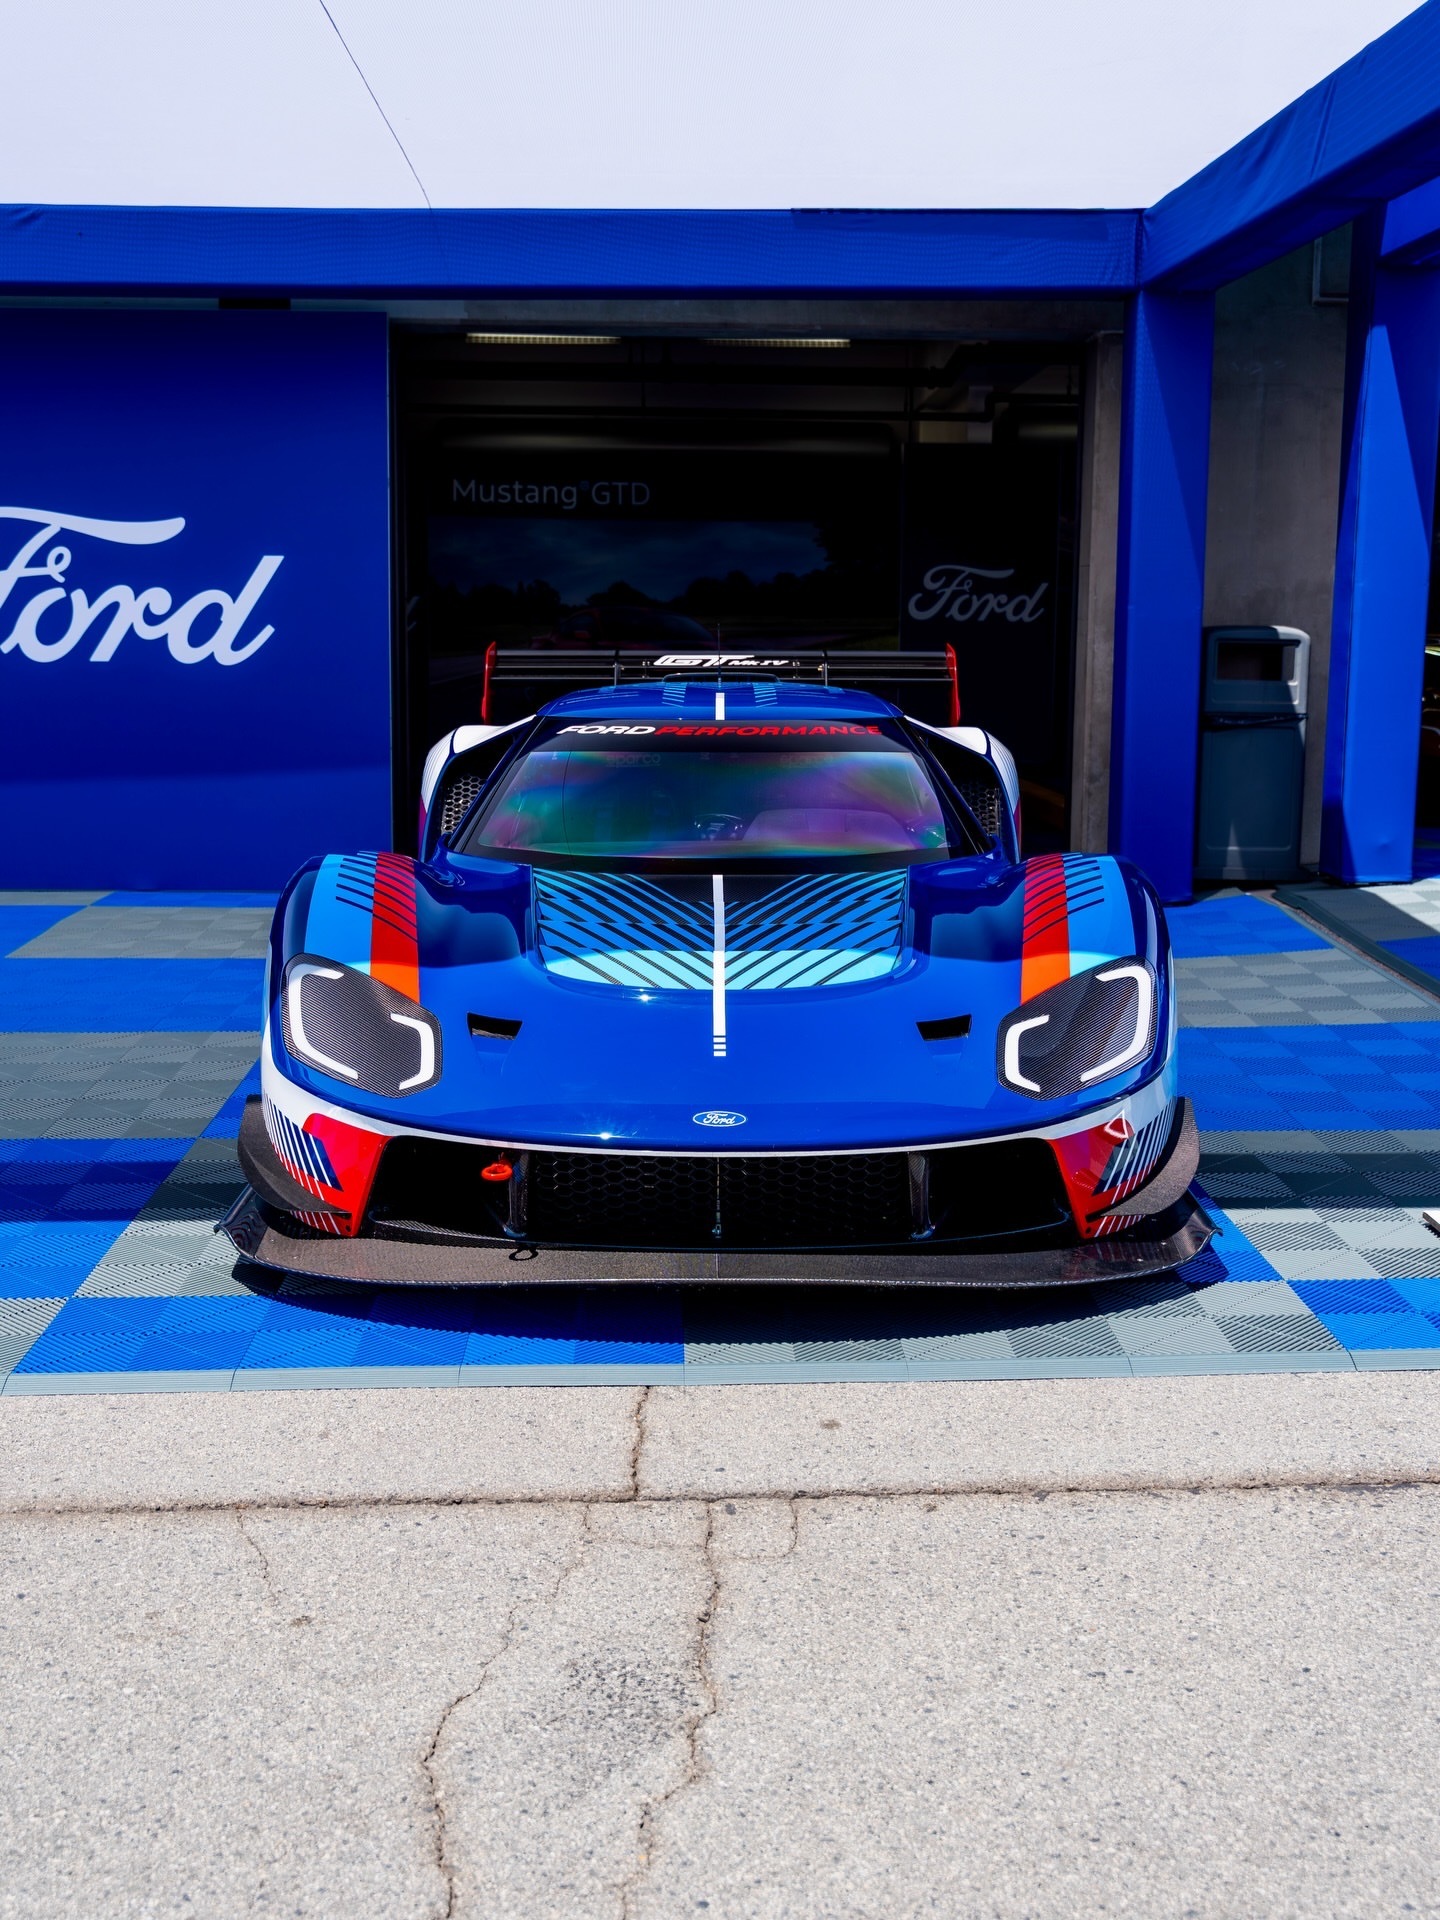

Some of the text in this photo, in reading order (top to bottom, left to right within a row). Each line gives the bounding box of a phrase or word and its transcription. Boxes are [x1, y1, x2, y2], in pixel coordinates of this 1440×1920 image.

[591, 481, 651, 506] GTD
[907, 564, 1049, 623] Ford
[703, 1112, 736, 1125] Ford
